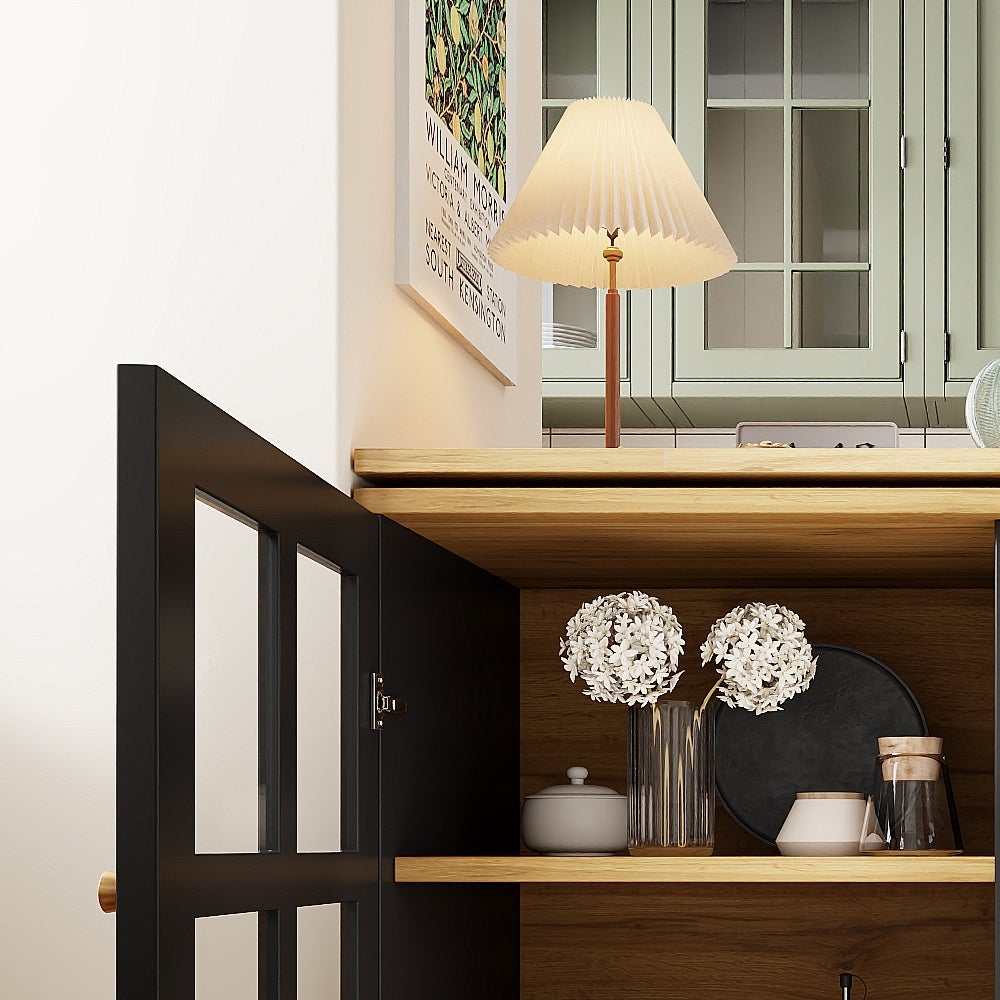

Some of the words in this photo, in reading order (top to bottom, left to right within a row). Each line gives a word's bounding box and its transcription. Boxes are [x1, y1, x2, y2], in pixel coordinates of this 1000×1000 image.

[425, 111, 468, 188] WILLIAM
[425, 162, 455, 212] VICTORIA
[456, 200, 461, 217] &
[464, 210, 483, 242] ALBERT
[425, 217, 452, 259] NEAREST
[486, 284, 506, 318] STATION
[425, 242, 455, 291] SOUTH
[459, 278, 506, 344] KENSINGTON
